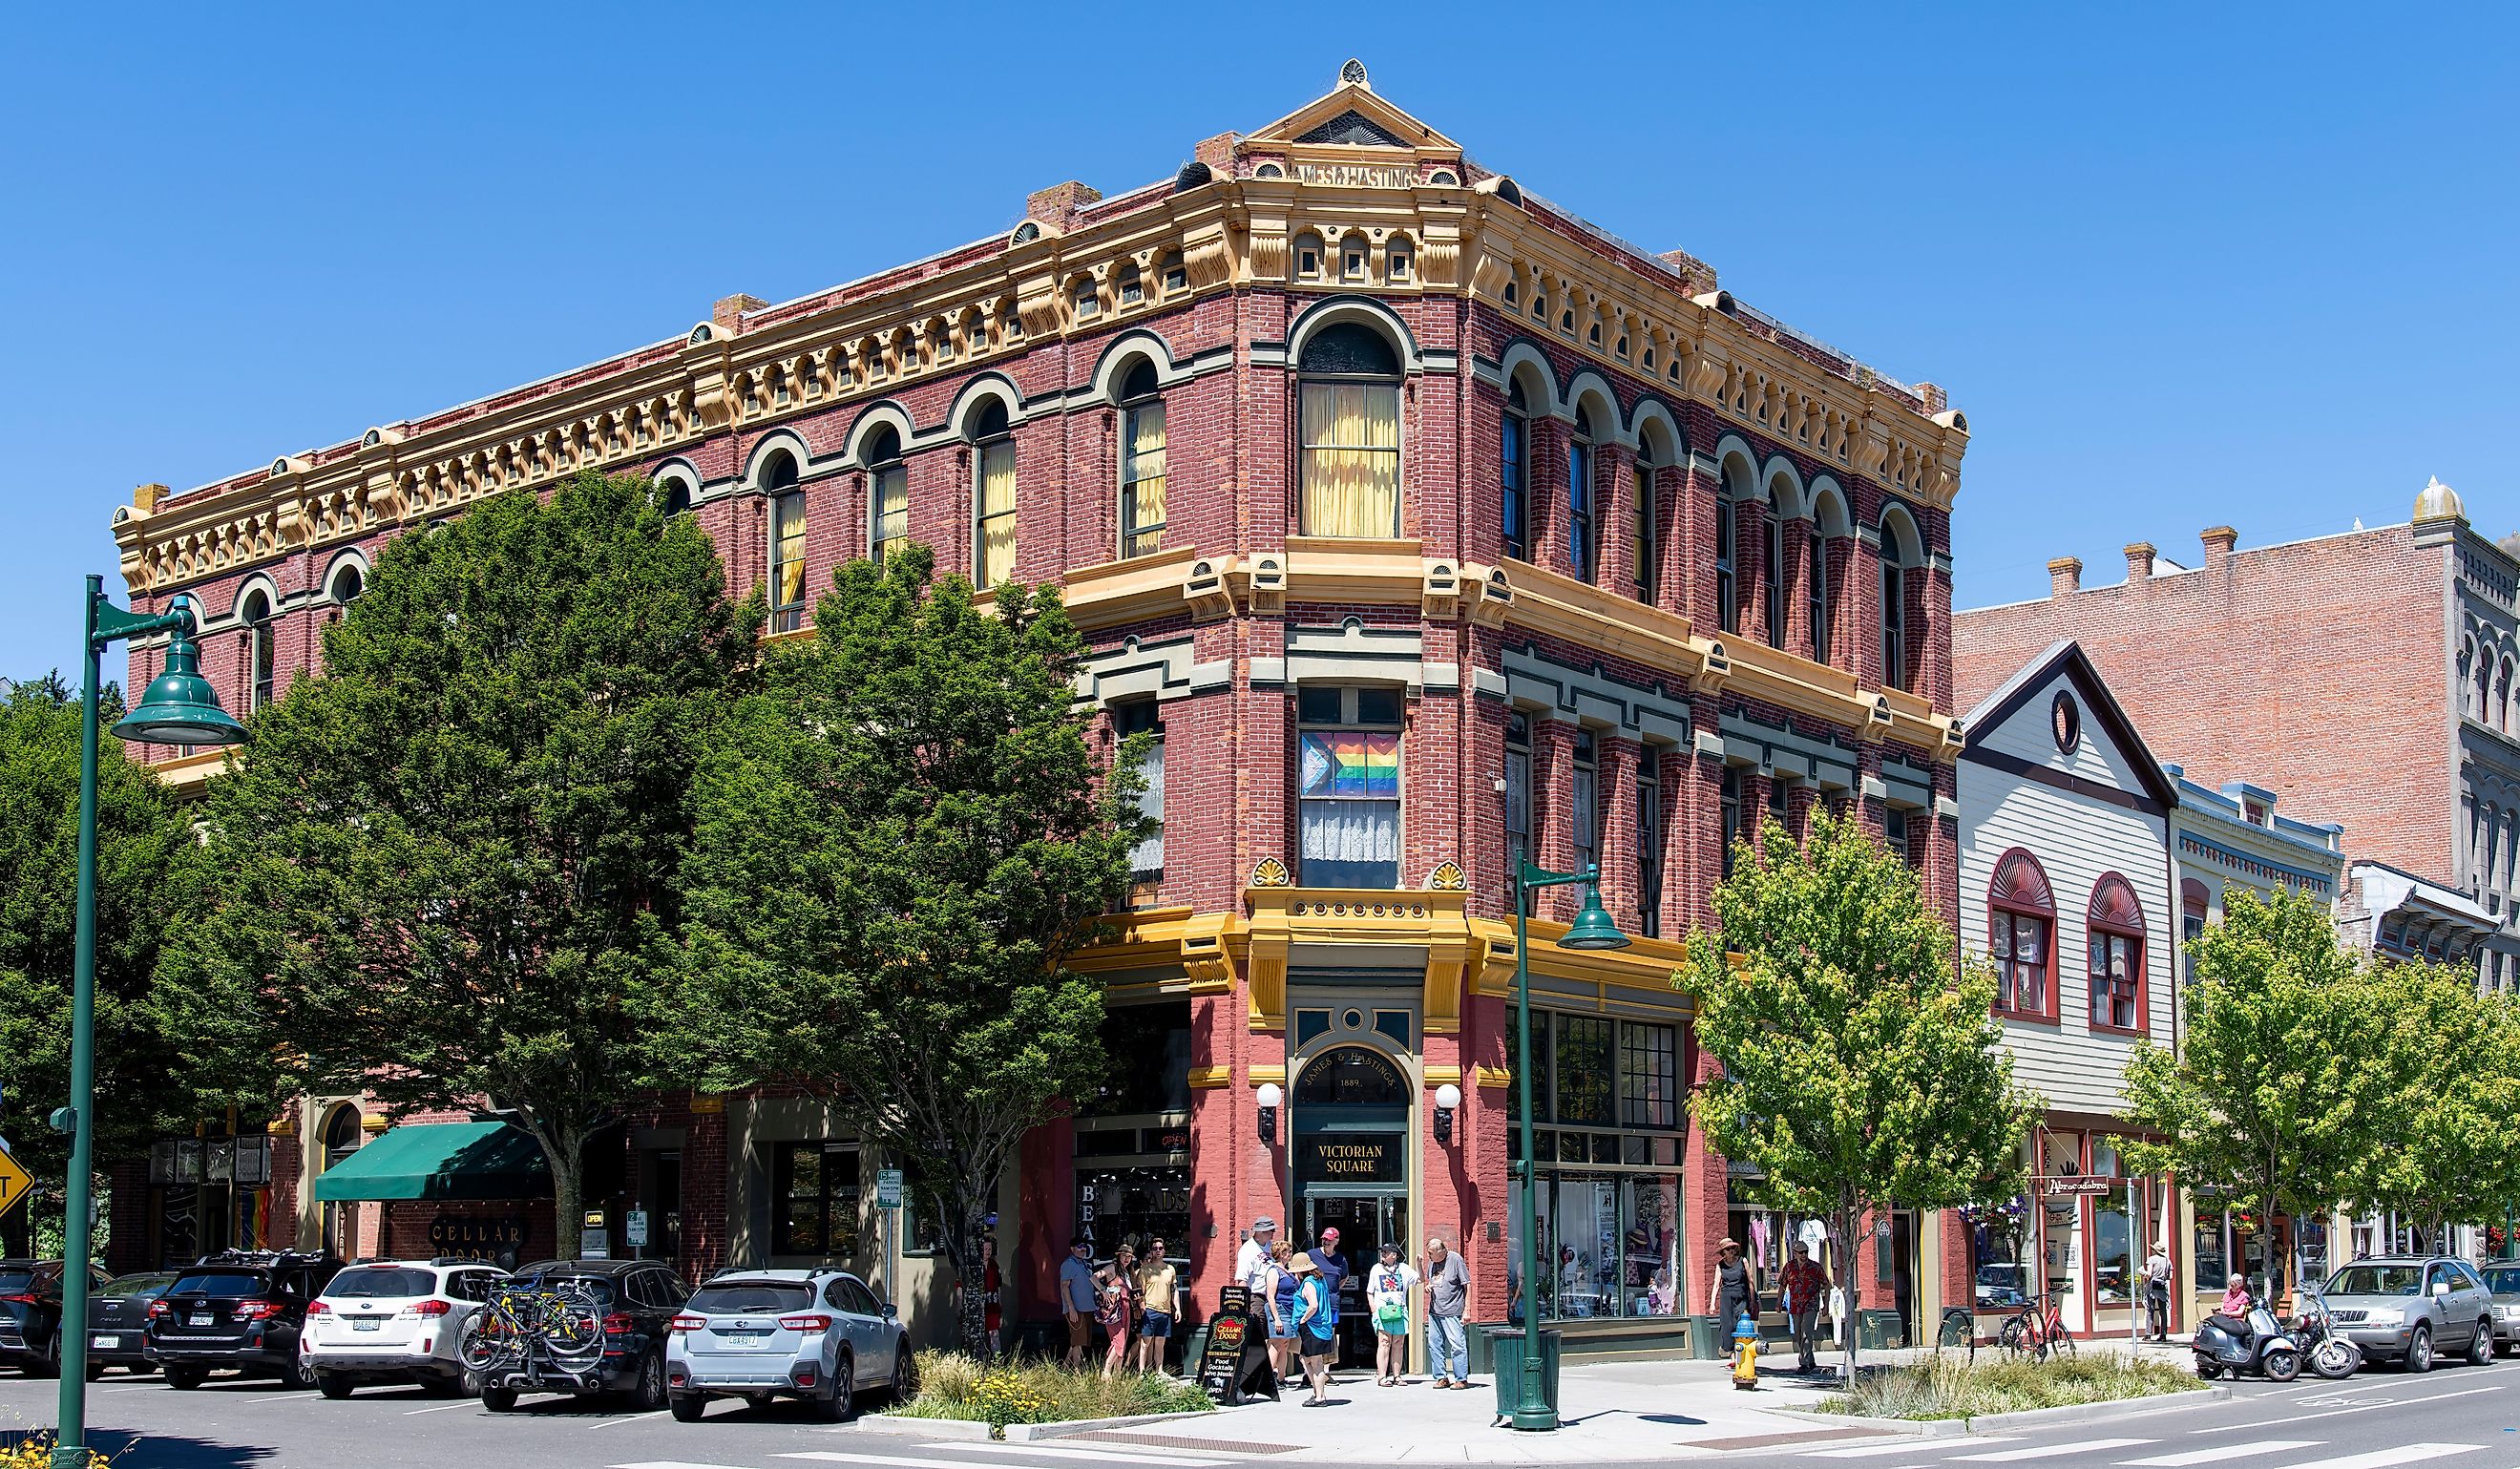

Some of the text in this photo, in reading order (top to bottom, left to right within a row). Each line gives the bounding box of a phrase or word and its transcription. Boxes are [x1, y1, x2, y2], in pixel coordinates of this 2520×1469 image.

[1348, 166, 1420, 187] HASTINGS
[1305, 1052, 1396, 1086] JAMES & HASTINGS
[1162, 1134, 1186, 1145] OPEN
[1318, 1145, 1383, 1158] VICTORIAN
[1326, 1160, 1375, 1173] SQUARE
[880, 1171, 888, 1180] 15
[2048, 1179, 2108, 1194] Abracadabra
[587, 1214, 602, 1223] OPEN
[432, 1226, 519, 1242] CELLAR
[441, 1248, 495, 1262] DOOR
[1217, 1325, 1241, 1333] CELLAR
